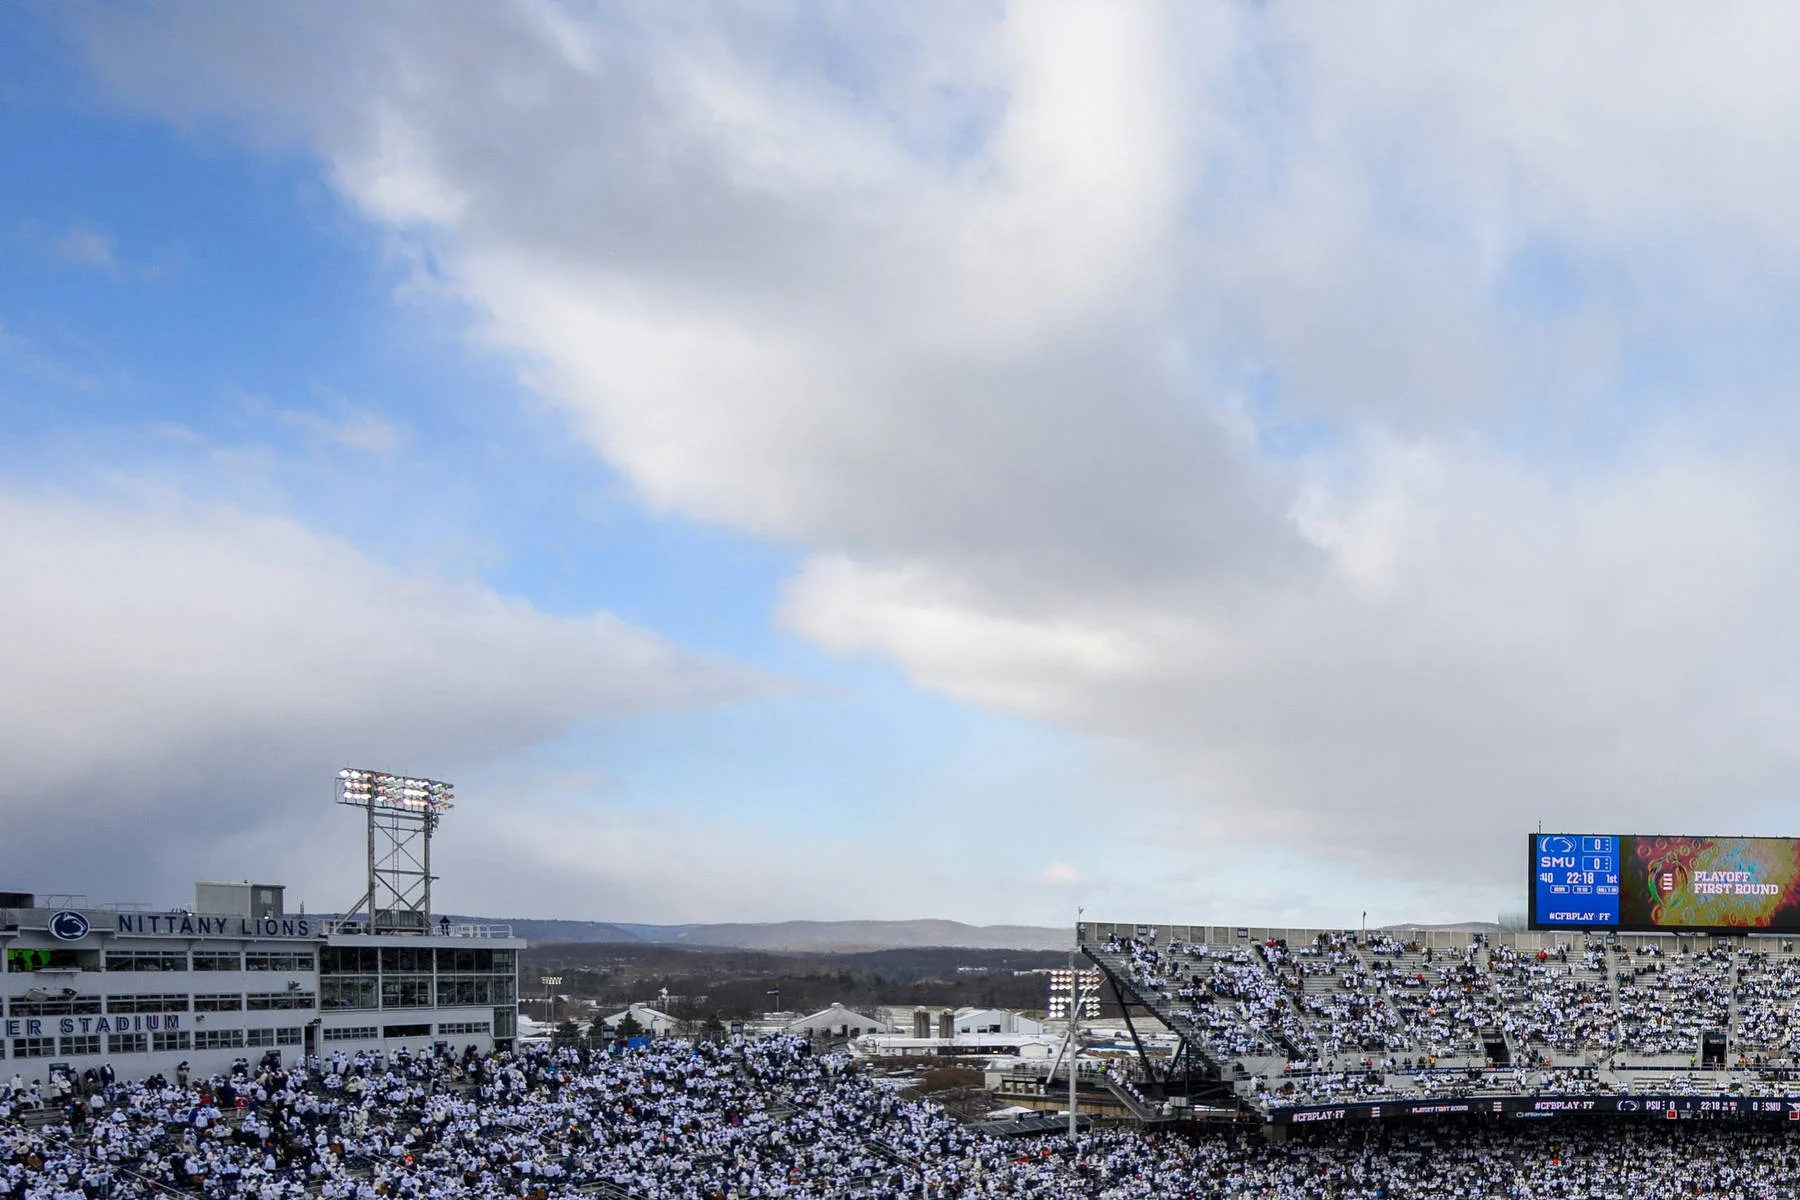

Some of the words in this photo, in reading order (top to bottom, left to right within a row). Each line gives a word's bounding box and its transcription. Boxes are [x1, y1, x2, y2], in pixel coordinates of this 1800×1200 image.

[1594, 838, 1601, 850] 0
[1541, 856, 1576, 868] SMU
[1594, 857, 1600, 870] 0
[1566, 872, 1595, 884] 22:18
[1606, 874, 1618, 884] 1st
[1694, 871, 1751, 882] PLAYOFF
[1694, 883, 1732, 894] FIRST
[1734, 884, 1779, 895] ROUND
[118, 914, 228, 934] NITTANY
[241, 918, 310, 936] LIONS
[60, 1014, 182, 1035] STADIUM
[1646, 1101, 1660, 1110] PSU
[1701, 1101, 1720, 1110] 22:18
[1765, 1101, 1781, 1111] SMU
